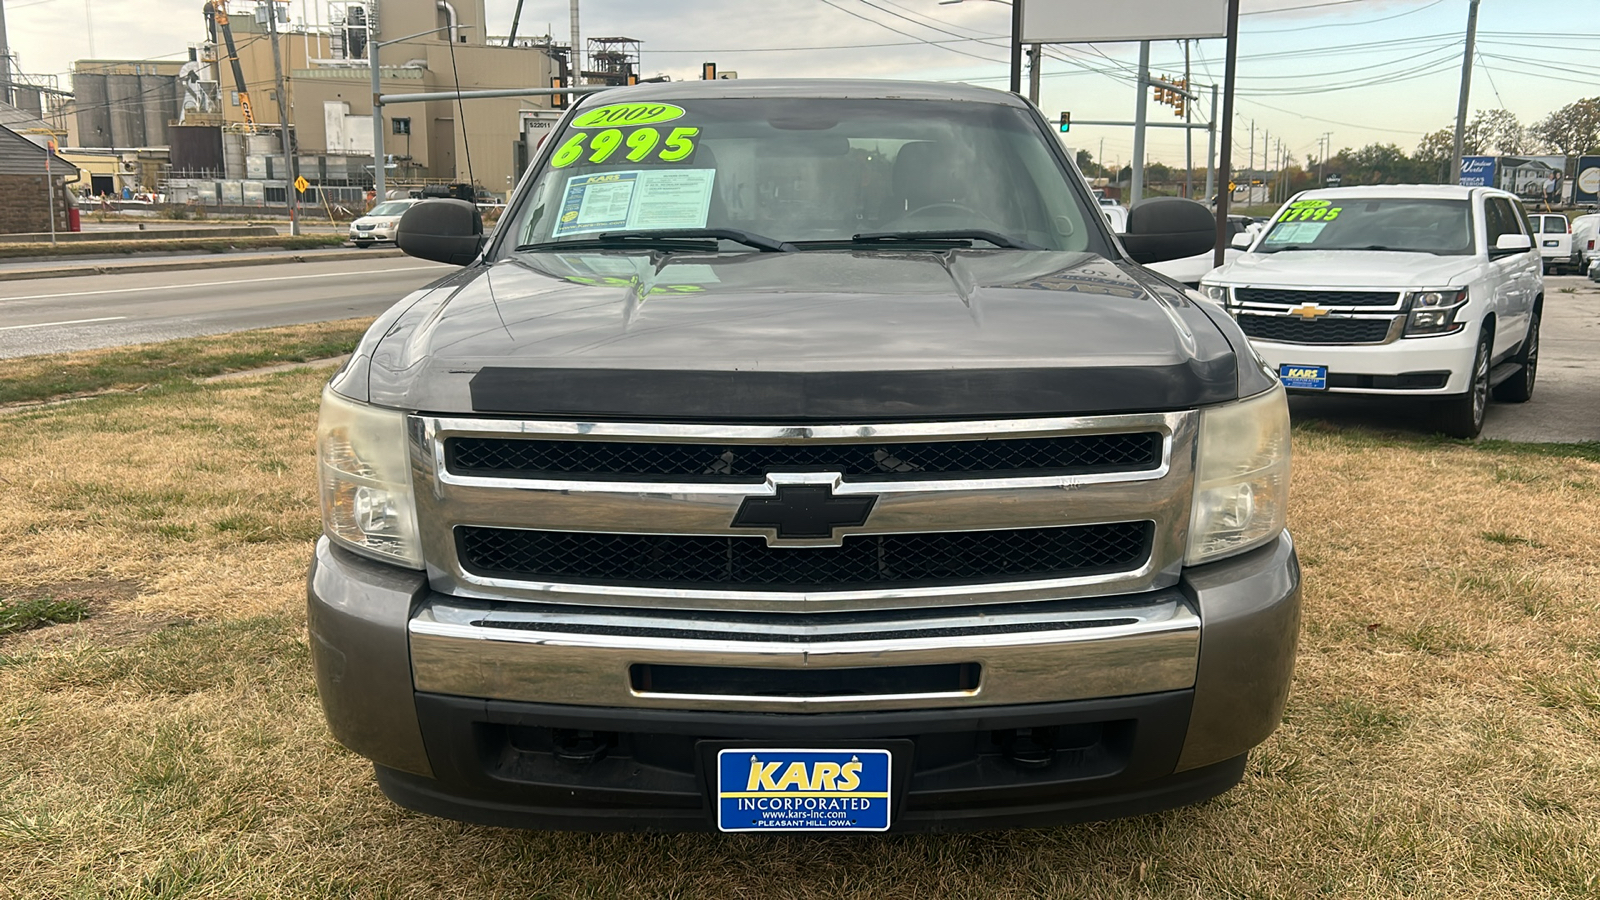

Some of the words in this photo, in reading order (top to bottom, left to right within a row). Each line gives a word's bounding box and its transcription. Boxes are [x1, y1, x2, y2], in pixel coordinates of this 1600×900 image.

[585, 107, 666, 125] 2009
[551, 127, 700, 168] 6995
[586, 174, 621, 183] KARS
[1278, 207, 1342, 222] 17995
[1288, 368, 1318, 378] KARS
[746, 761, 863, 791] KARS
[738, 797, 871, 811] INCORPORATED
[758, 819, 805, 827] PLEASANT
[828, 819, 851, 827] IOWA
